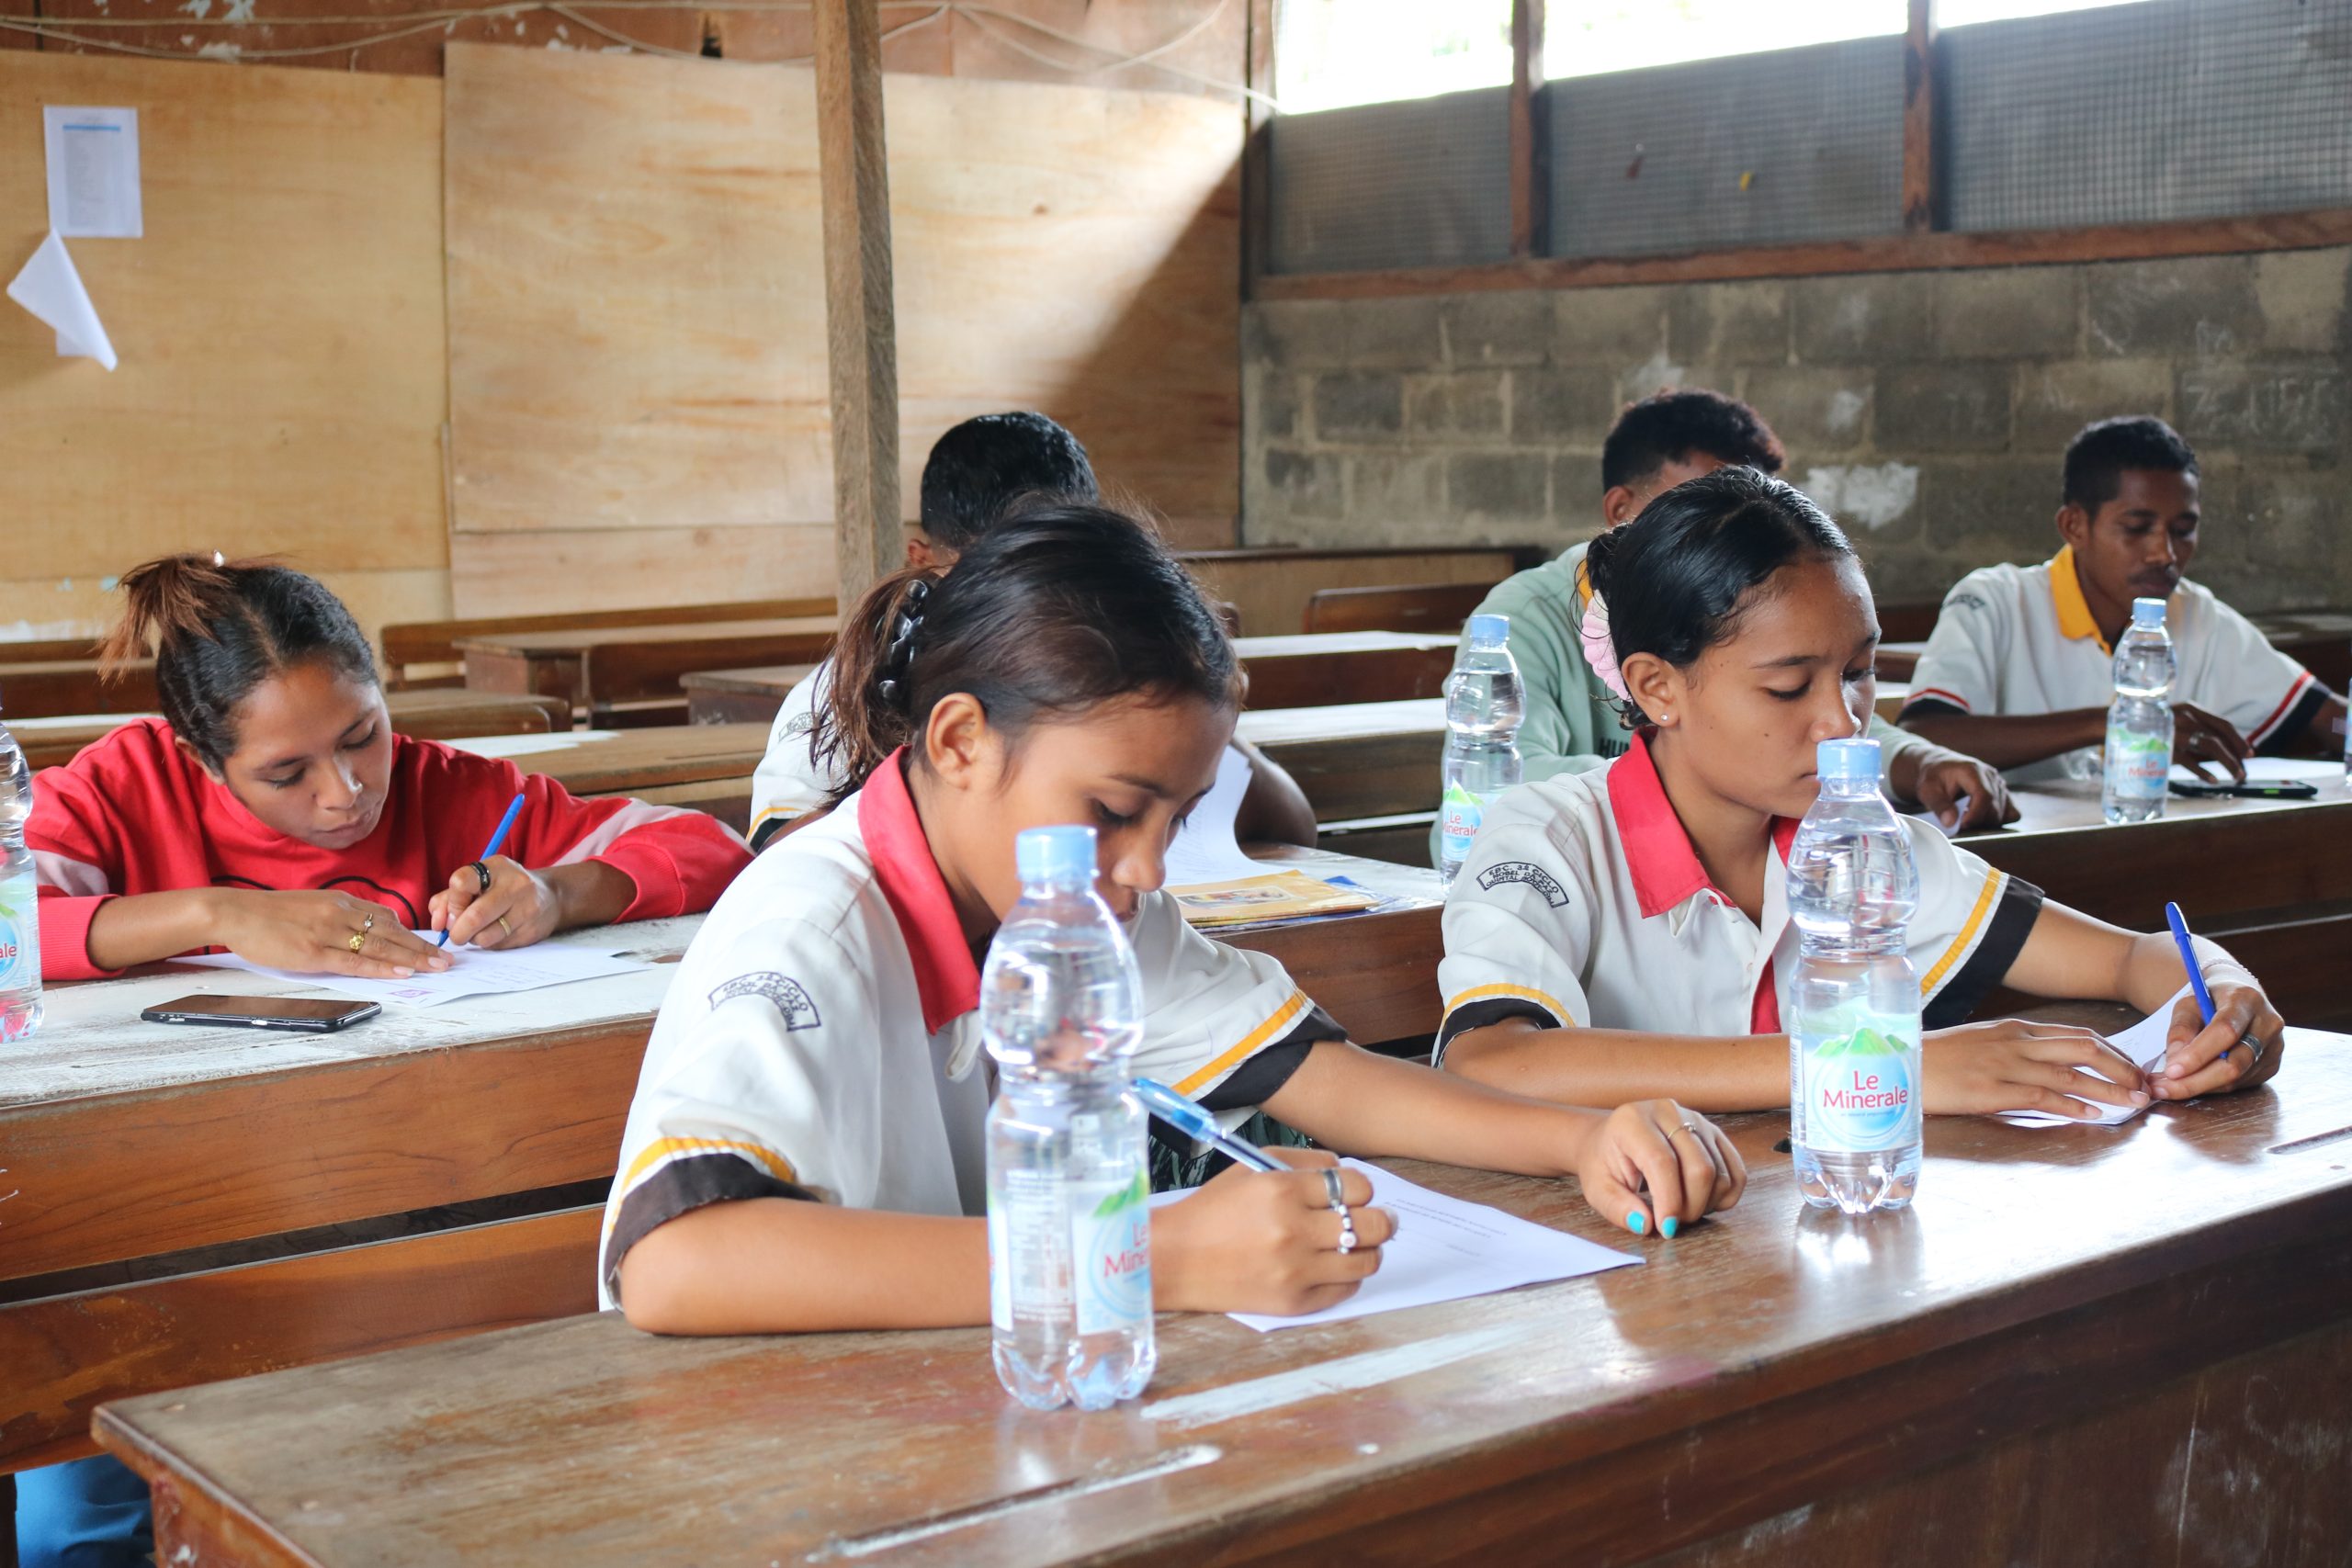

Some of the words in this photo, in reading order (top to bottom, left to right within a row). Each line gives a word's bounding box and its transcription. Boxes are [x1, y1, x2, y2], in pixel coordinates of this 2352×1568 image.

[1450, 810, 1461, 824] Le
[1532, 868, 1559, 894] CICLO
[1853, 1070, 1879, 1091] Le
[1823, 1086, 1908, 1109] Minerale
